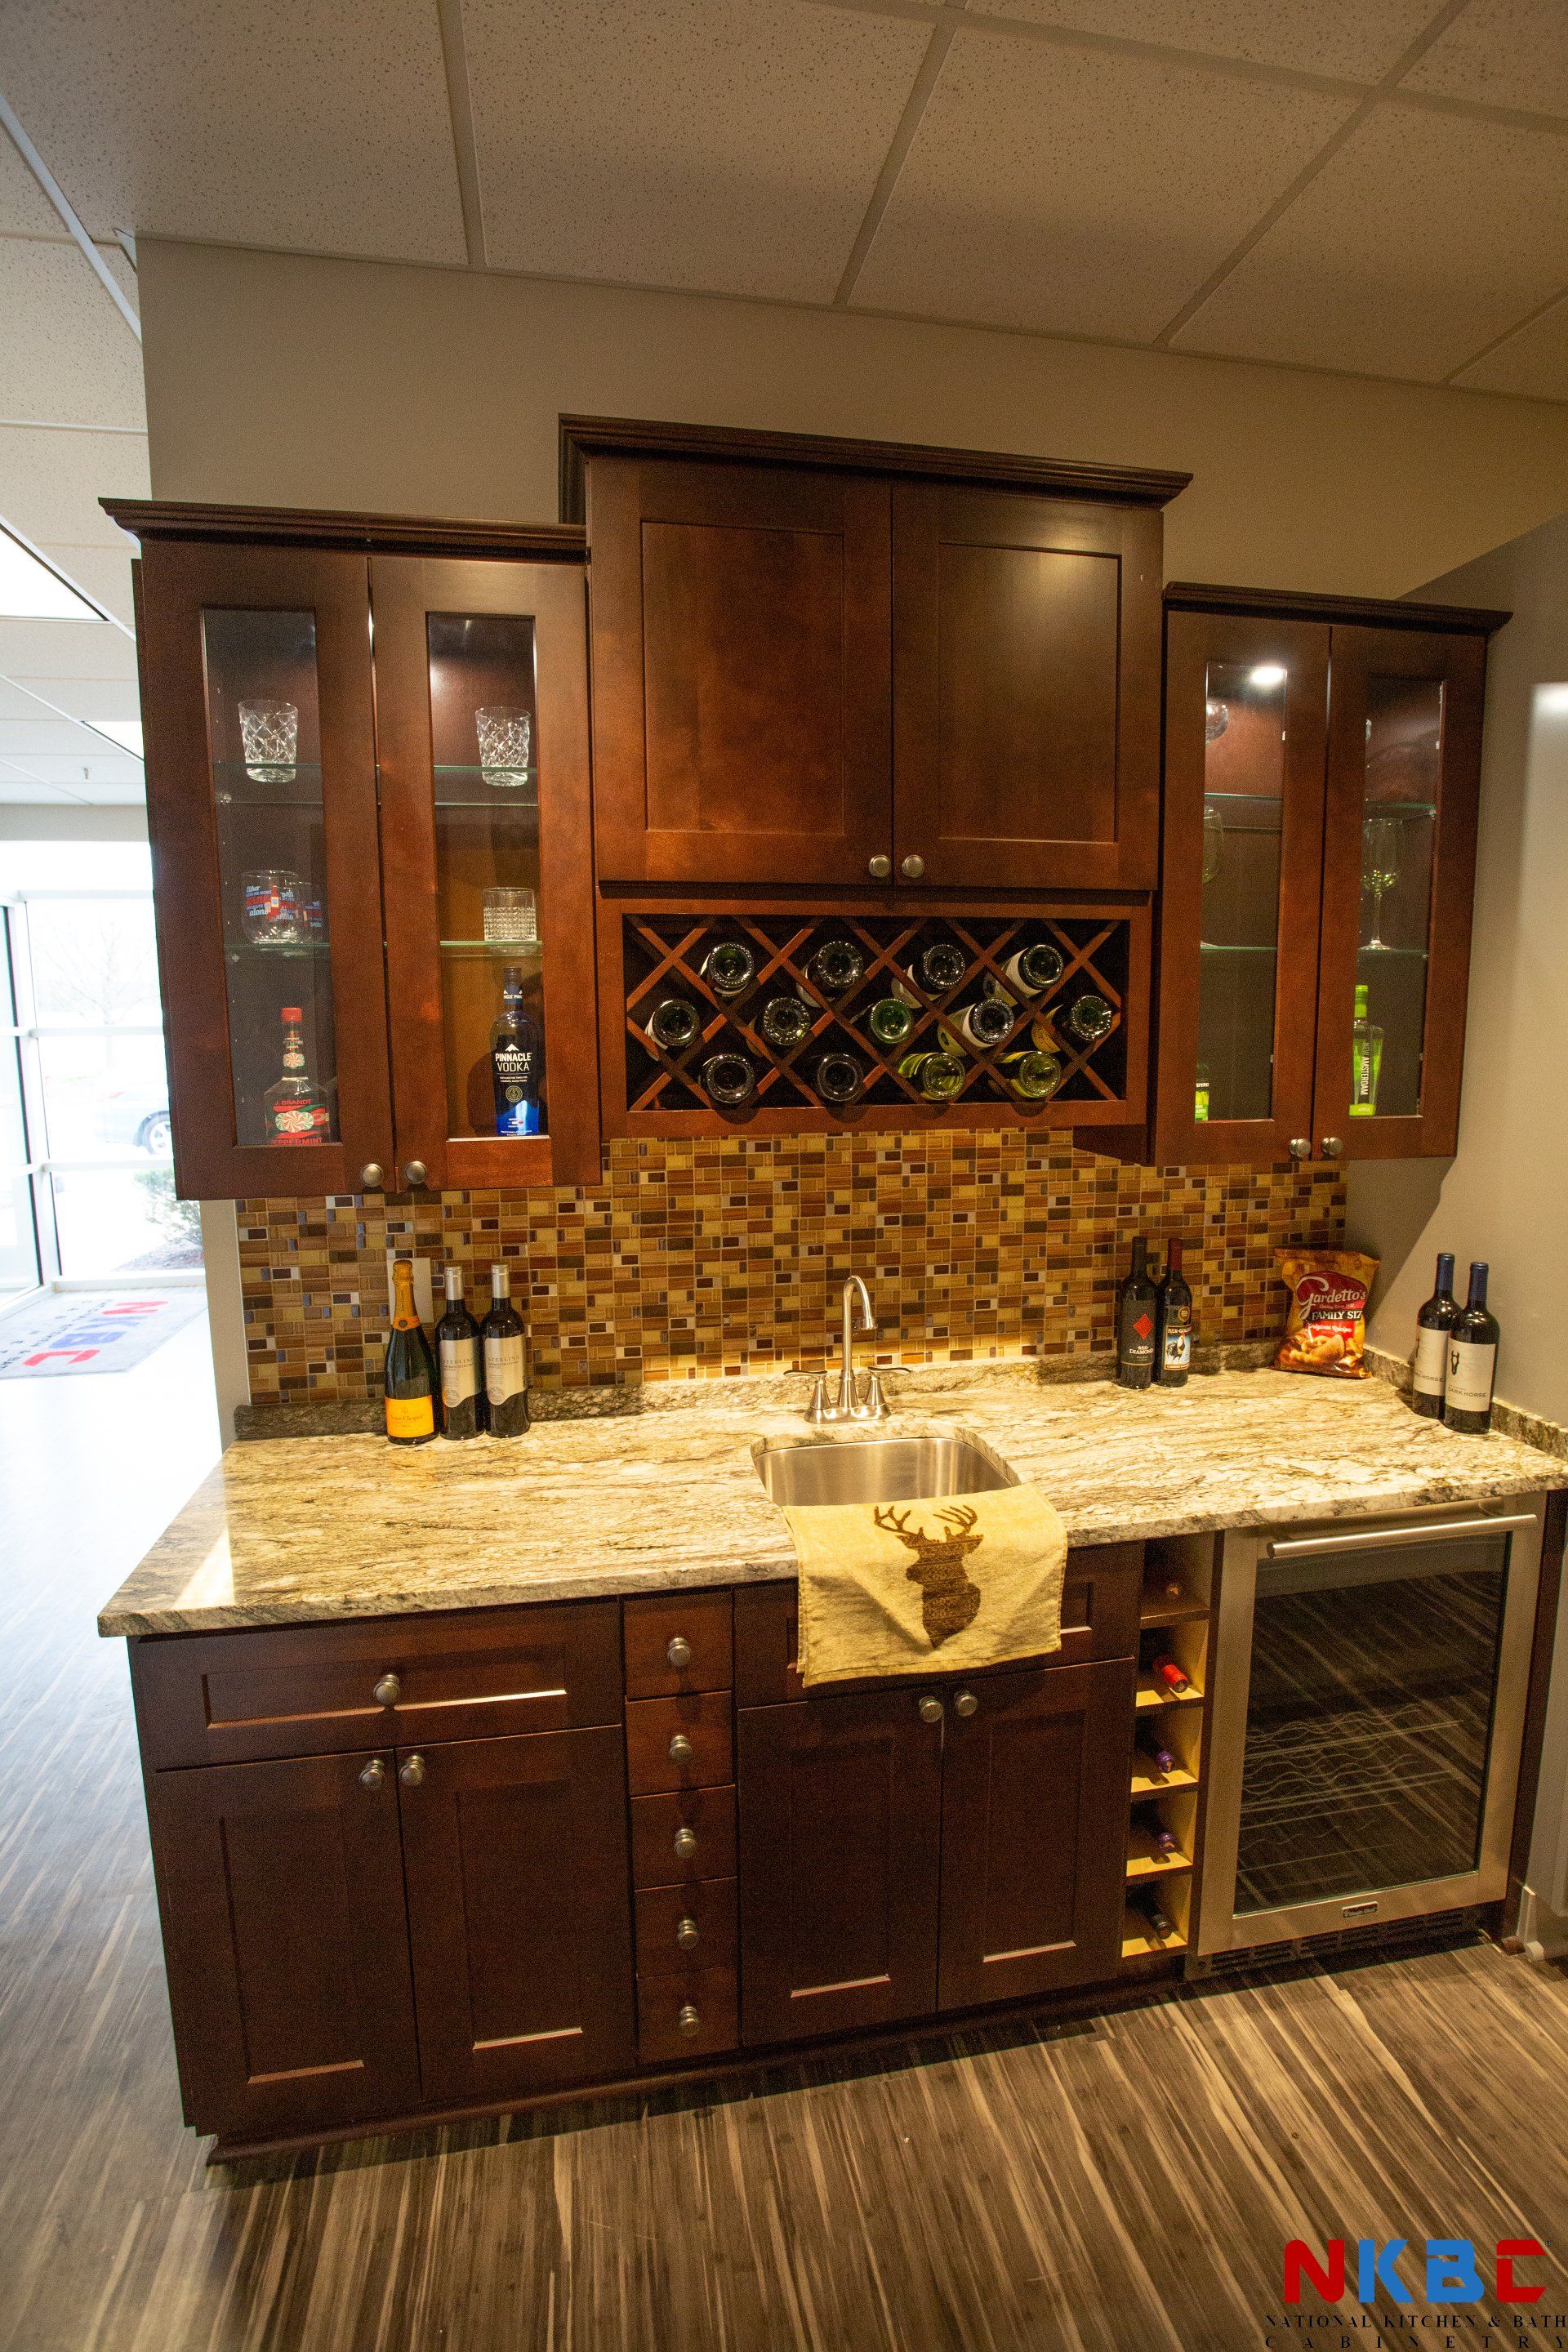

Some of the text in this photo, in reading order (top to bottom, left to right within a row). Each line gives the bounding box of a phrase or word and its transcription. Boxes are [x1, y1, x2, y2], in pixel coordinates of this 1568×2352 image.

[495, 1053, 532, 1062] PINNACLE
[497, 1062, 530, 1071] VODKA
[1361, 1057, 1370, 1095] AMSTERDAM
[1296, 1276, 1366, 1321] Gardetto's
[1347, 1310, 1363, 1320] SIZ
